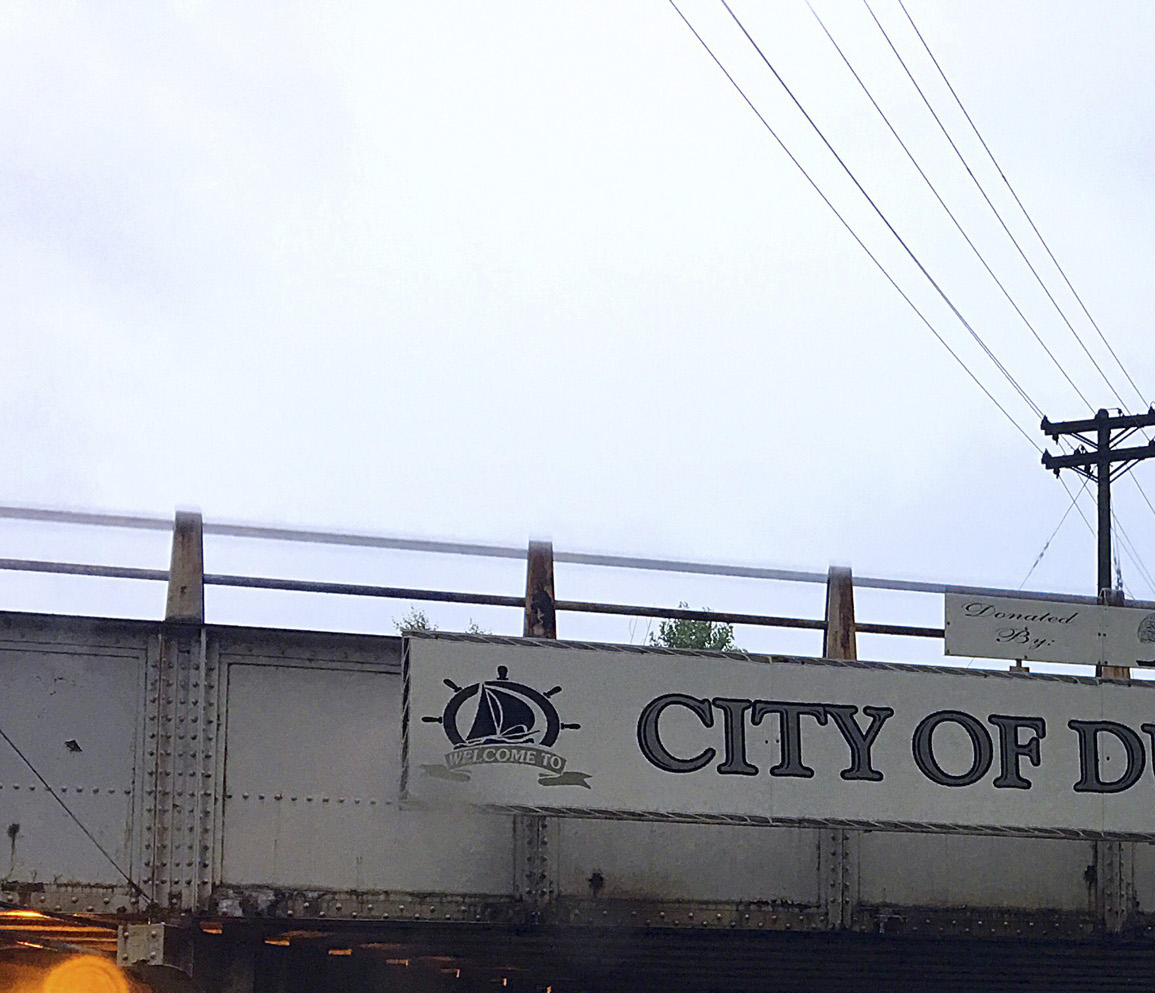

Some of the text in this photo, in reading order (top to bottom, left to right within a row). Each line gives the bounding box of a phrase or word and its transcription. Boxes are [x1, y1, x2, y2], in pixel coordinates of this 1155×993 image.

[961, 602, 1078, 625] Donated
[995, 626, 1055, 650] By:
[636, 693, 894, 781] CITY
[911, 709, 1046, 789] OF
[449, 748, 562, 770] WELCOME TO
